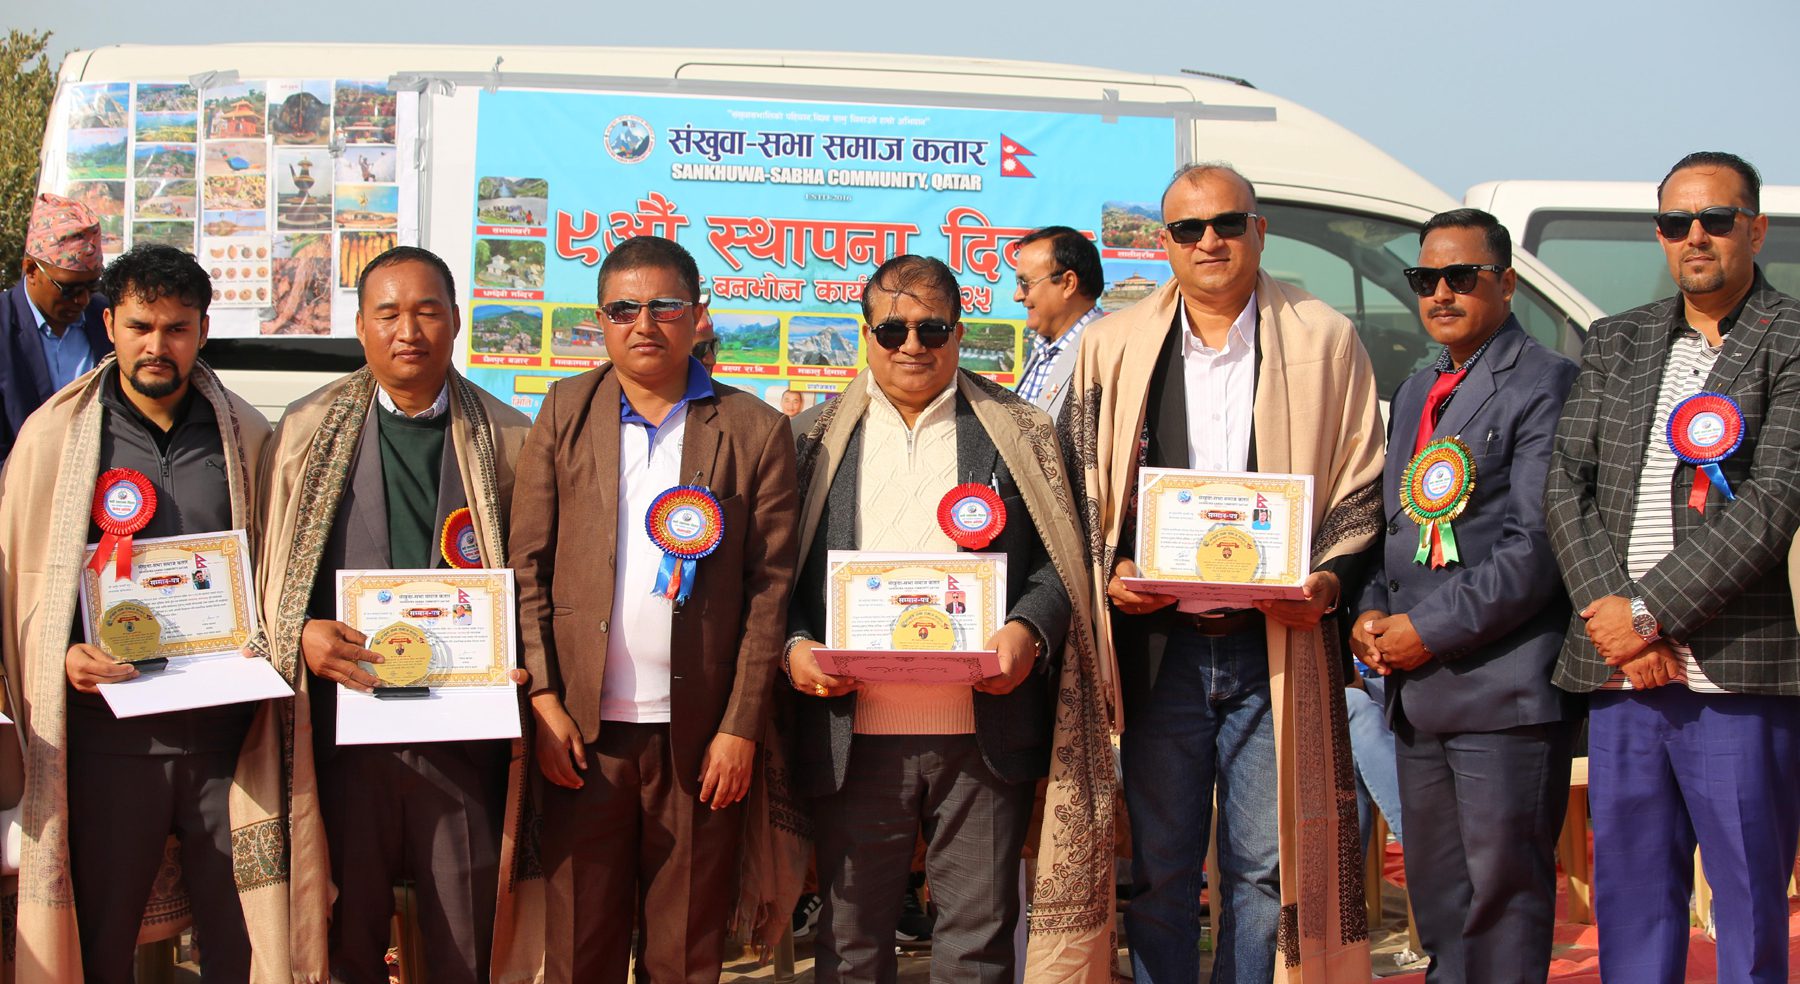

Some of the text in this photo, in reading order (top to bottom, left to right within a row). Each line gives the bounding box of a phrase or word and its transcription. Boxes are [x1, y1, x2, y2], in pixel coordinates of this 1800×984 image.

[668, 124, 815, 162] संखुवा-सभा
[822, 134, 905, 161] समाज
[913, 138, 989, 166] कतार
[671, 163, 982, 192] SANKHUWA-SABHA COMMUNITY, QATAR
[705, 215, 920, 271] स्थापना
[713, 271, 806, 301] बनभोज
